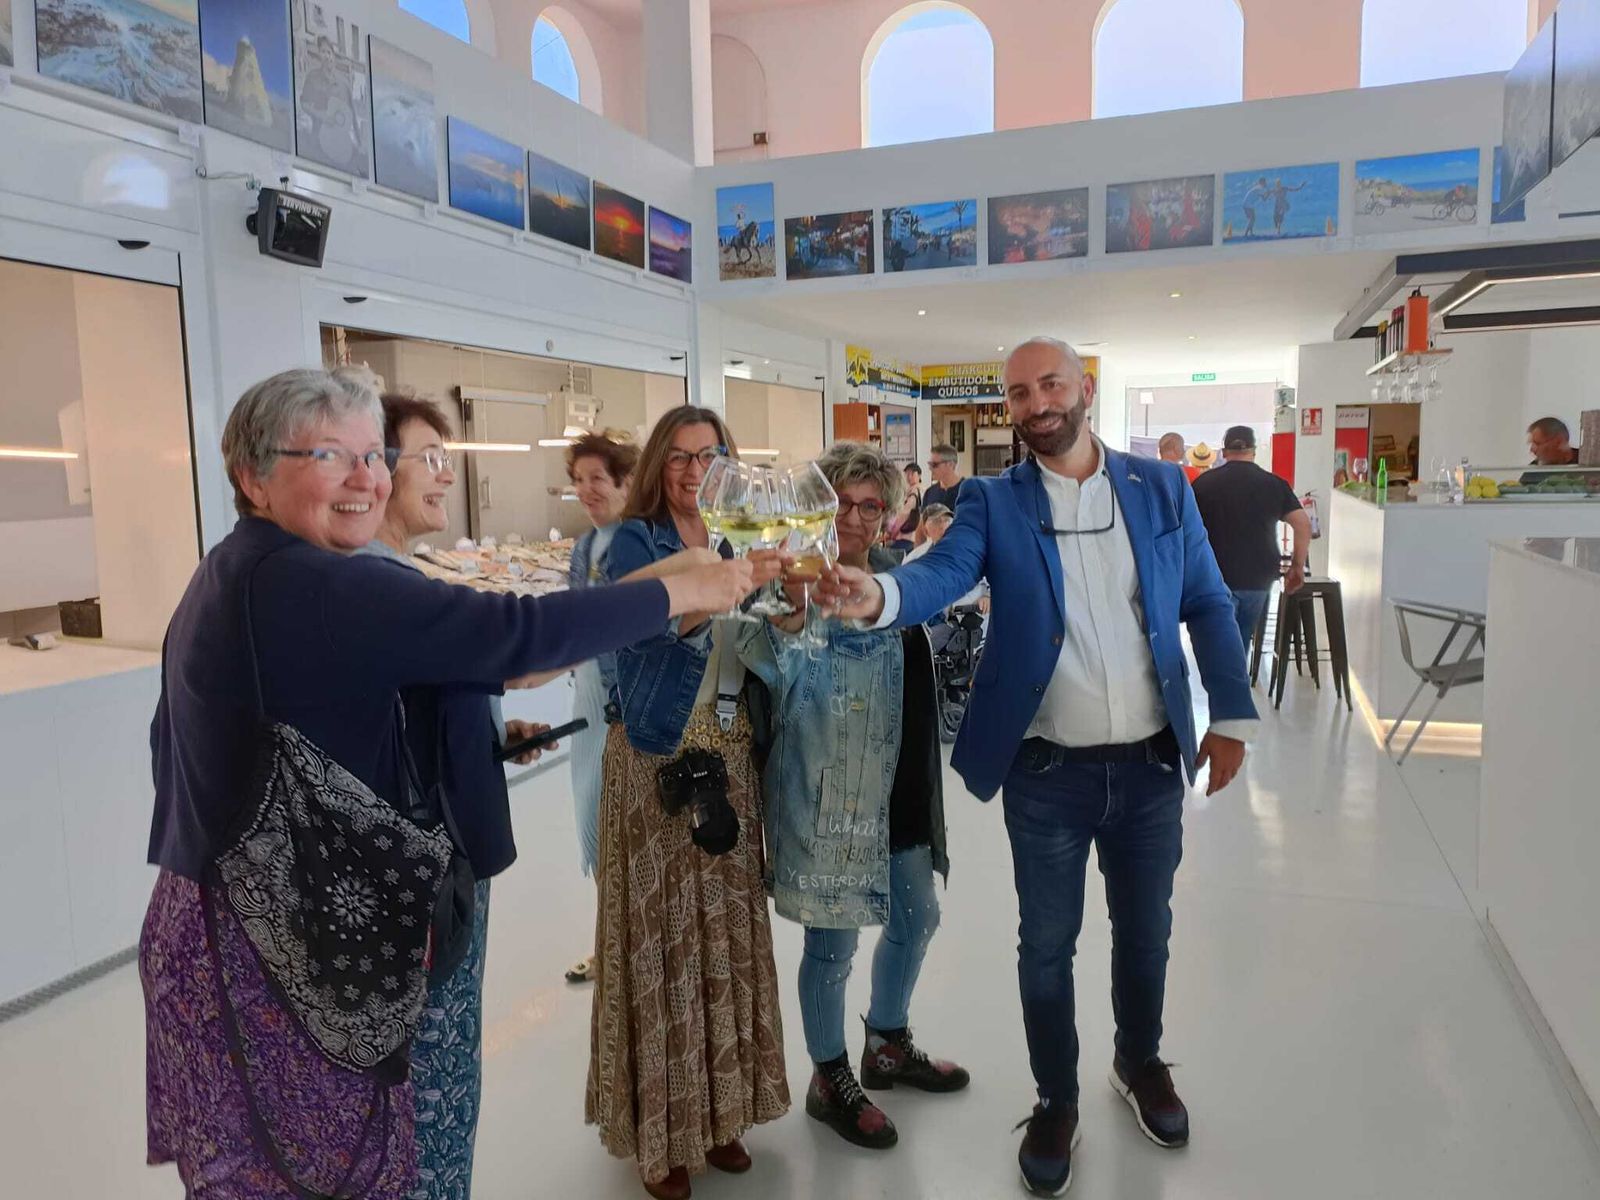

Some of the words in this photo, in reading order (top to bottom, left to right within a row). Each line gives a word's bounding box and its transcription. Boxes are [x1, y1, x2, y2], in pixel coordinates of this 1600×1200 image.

[929, 374, 988, 387] EMBUTIDOS
[938, 385, 978, 397] QUESOS
[787, 866, 876, 889] YESTERDAY
